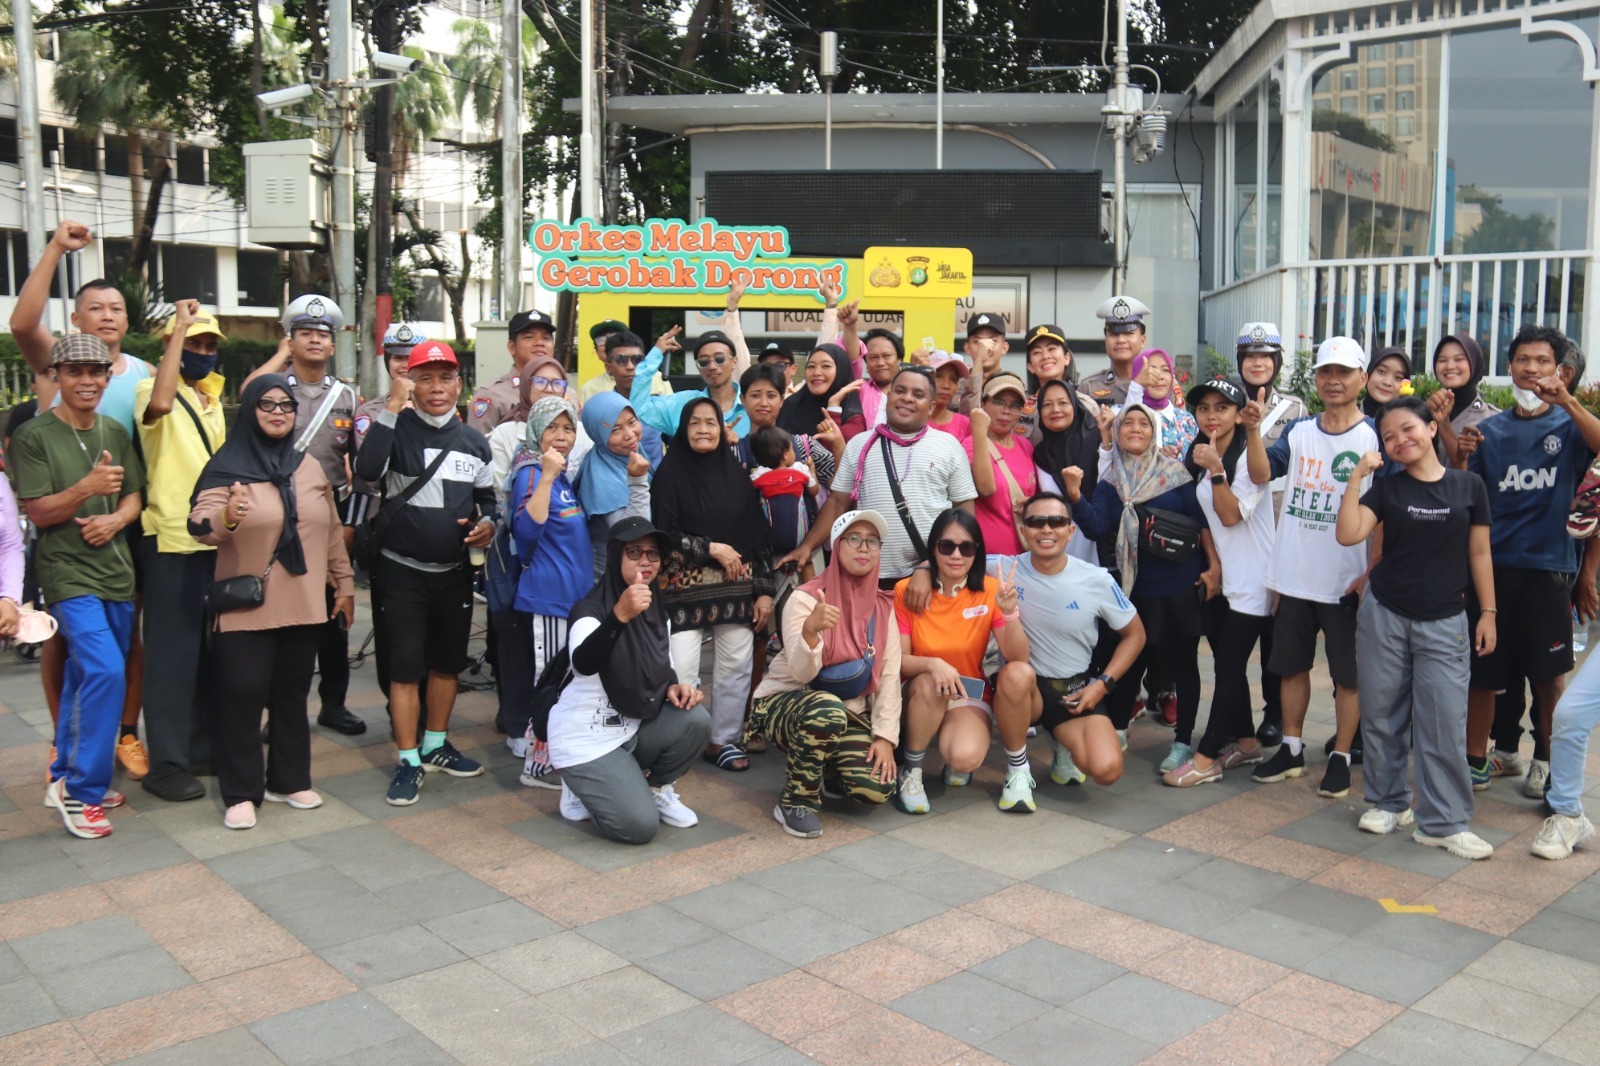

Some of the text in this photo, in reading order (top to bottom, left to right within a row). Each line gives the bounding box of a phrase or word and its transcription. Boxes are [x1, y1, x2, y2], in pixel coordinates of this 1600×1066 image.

[534, 222, 785, 260] Orkes Melayu
[541, 257, 843, 298] Gerobak Dorong
[1320, 481, 1336, 492] the
[1500, 464, 1558, 492] AON
[1291, 487, 1343, 511] FIEL
